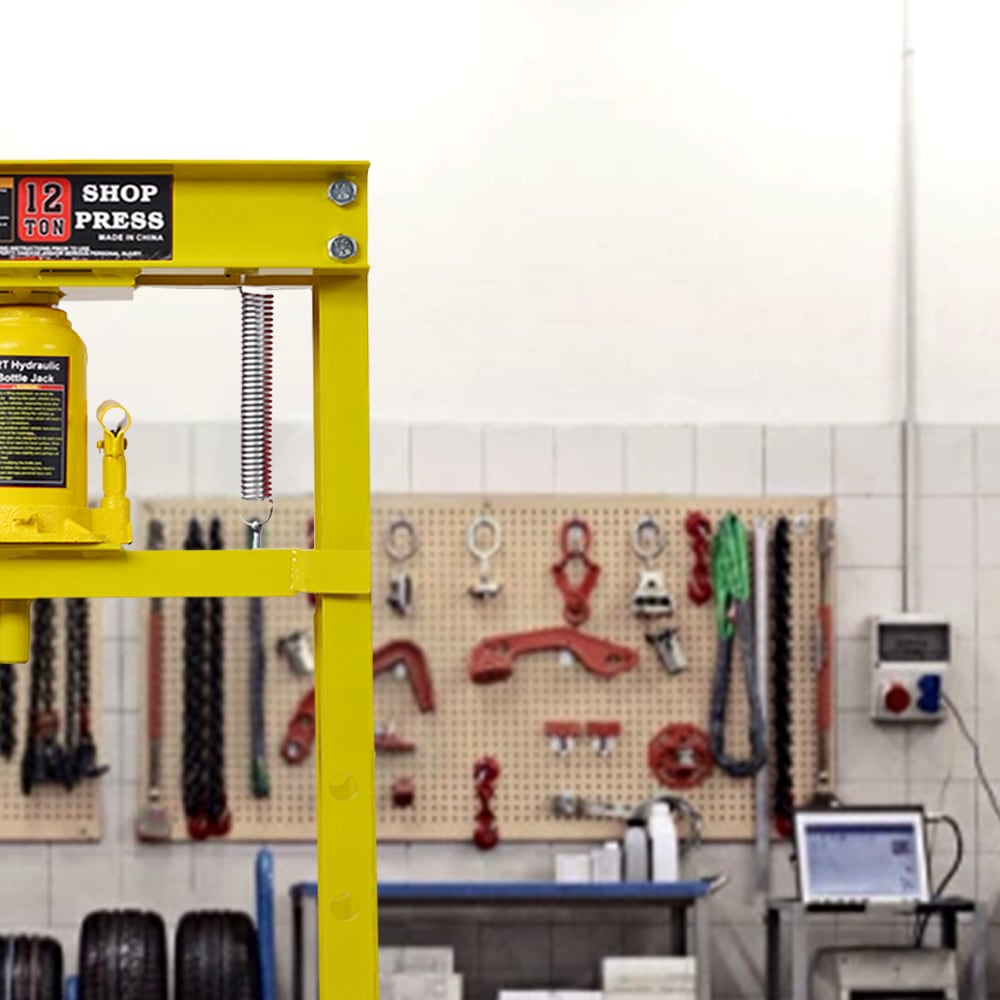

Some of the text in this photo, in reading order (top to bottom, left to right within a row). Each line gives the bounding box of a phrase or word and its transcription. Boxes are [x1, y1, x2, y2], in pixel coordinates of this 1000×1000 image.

[25, 182, 63, 215] 12
[82, 184, 158, 203] SHOP
[24, 218, 65, 236] TON
[74, 211, 165, 230] PRESS
[98, 233, 164, 241] MADE IN CHINA
[11, 360, 60, 371] Hydraulic
[30, 373, 54, 383] Jack
